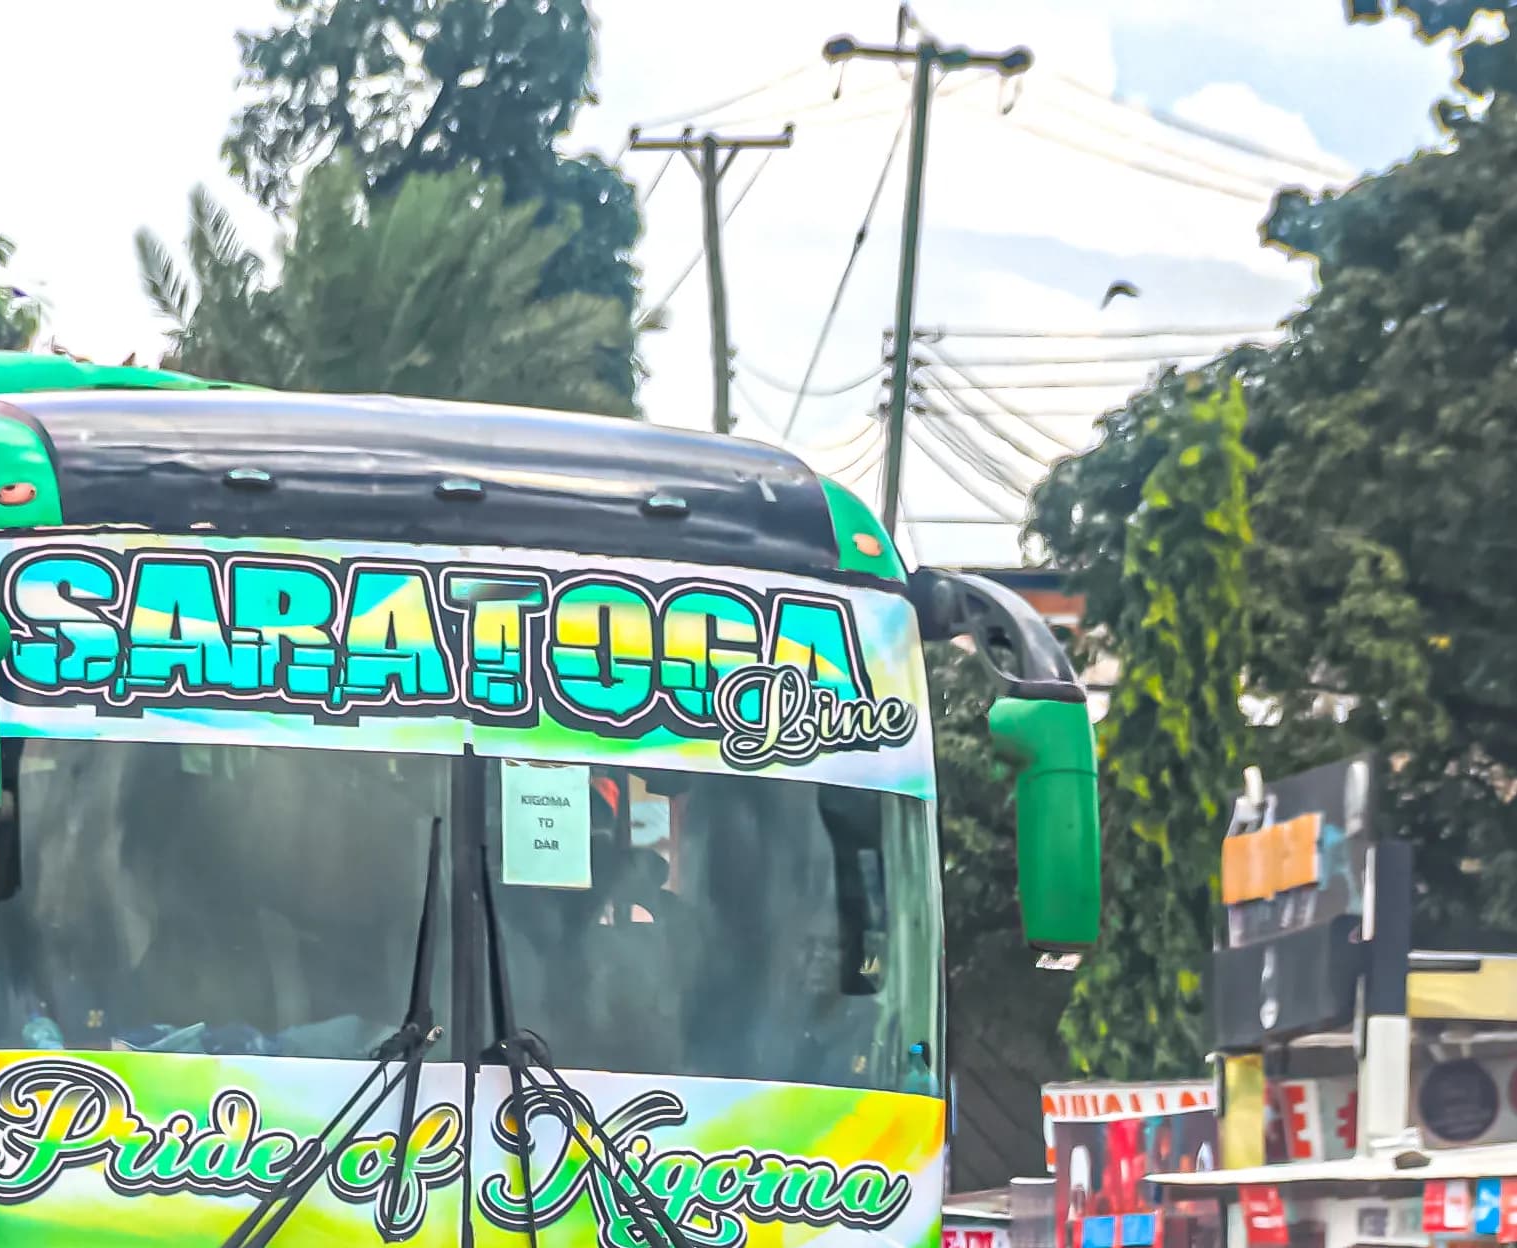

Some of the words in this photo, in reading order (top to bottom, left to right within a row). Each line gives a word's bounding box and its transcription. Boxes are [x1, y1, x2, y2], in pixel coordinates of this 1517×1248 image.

[1, 547, 876, 734] SARATOGA
[715, 665, 917, 768] Line
[520, 794, 571, 808] KIGOMA
[538, 817, 554, 829] TO
[533, 839, 560, 851] DAR
[330, 1102, 466, 1242] of
